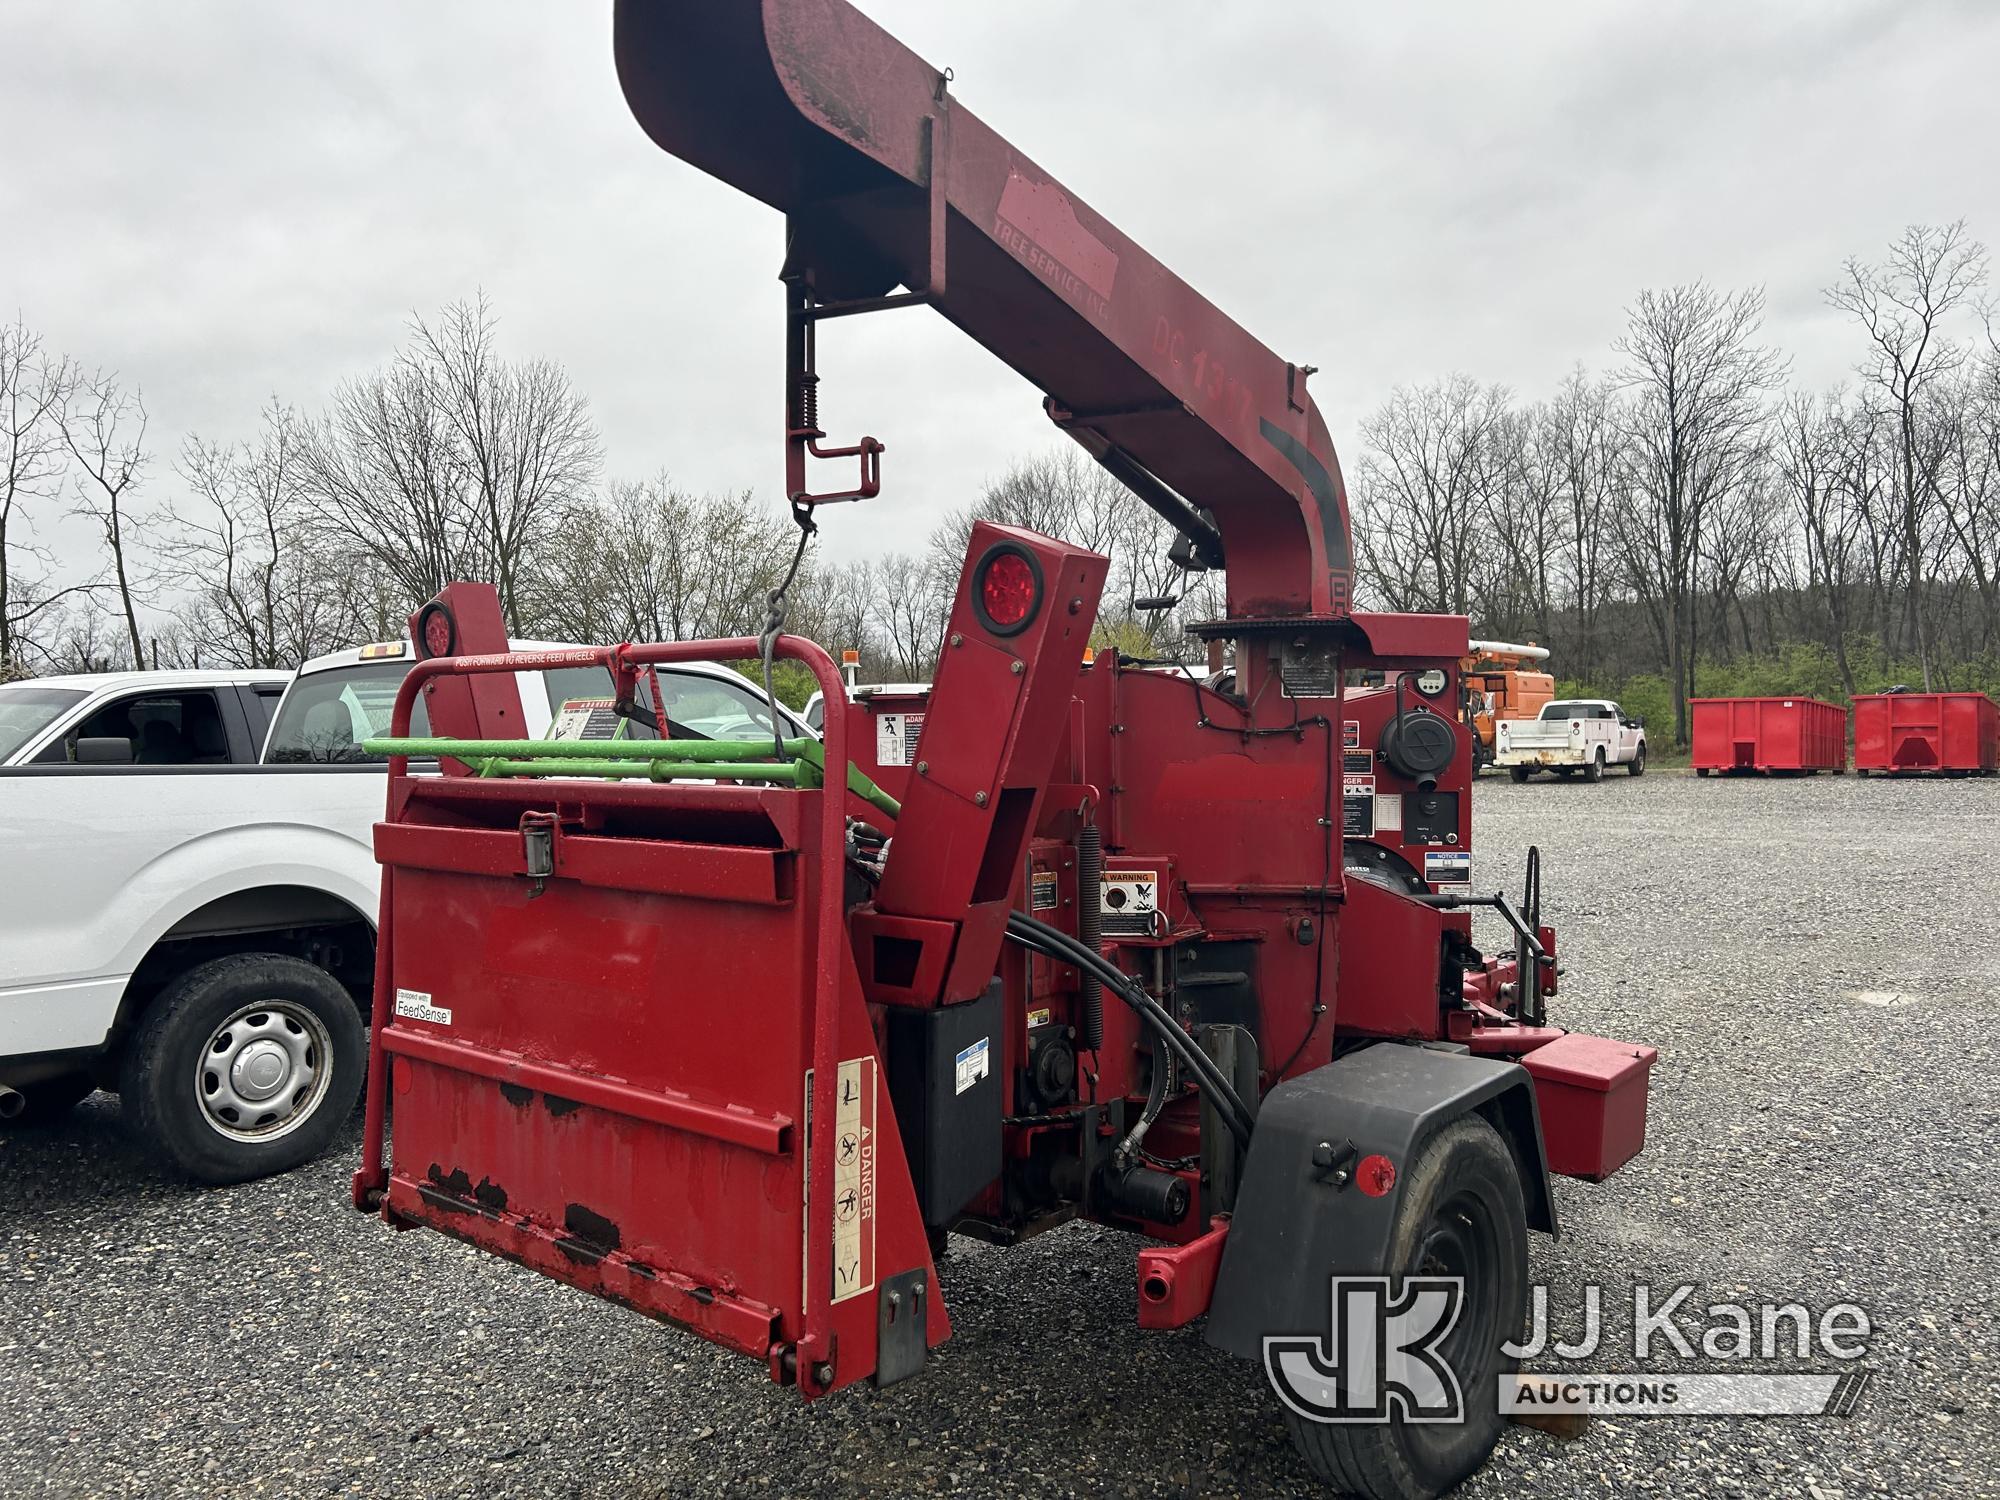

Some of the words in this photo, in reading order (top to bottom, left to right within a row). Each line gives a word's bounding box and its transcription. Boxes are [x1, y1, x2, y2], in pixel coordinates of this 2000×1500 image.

[993, 218, 1029, 256] TREE
[455, 658, 473, 667] PUSH
[473, 656, 504, 666] FORWARD
[505, 656, 515, 665] TO
[515, 653, 546, 664] REVERSE
[546, 652, 565, 662] FEED
[565, 650, 596, 661] WHEELS
[397, 990, 418, 1000] Equipped
[861, 1145, 873, 1220] DANGER
